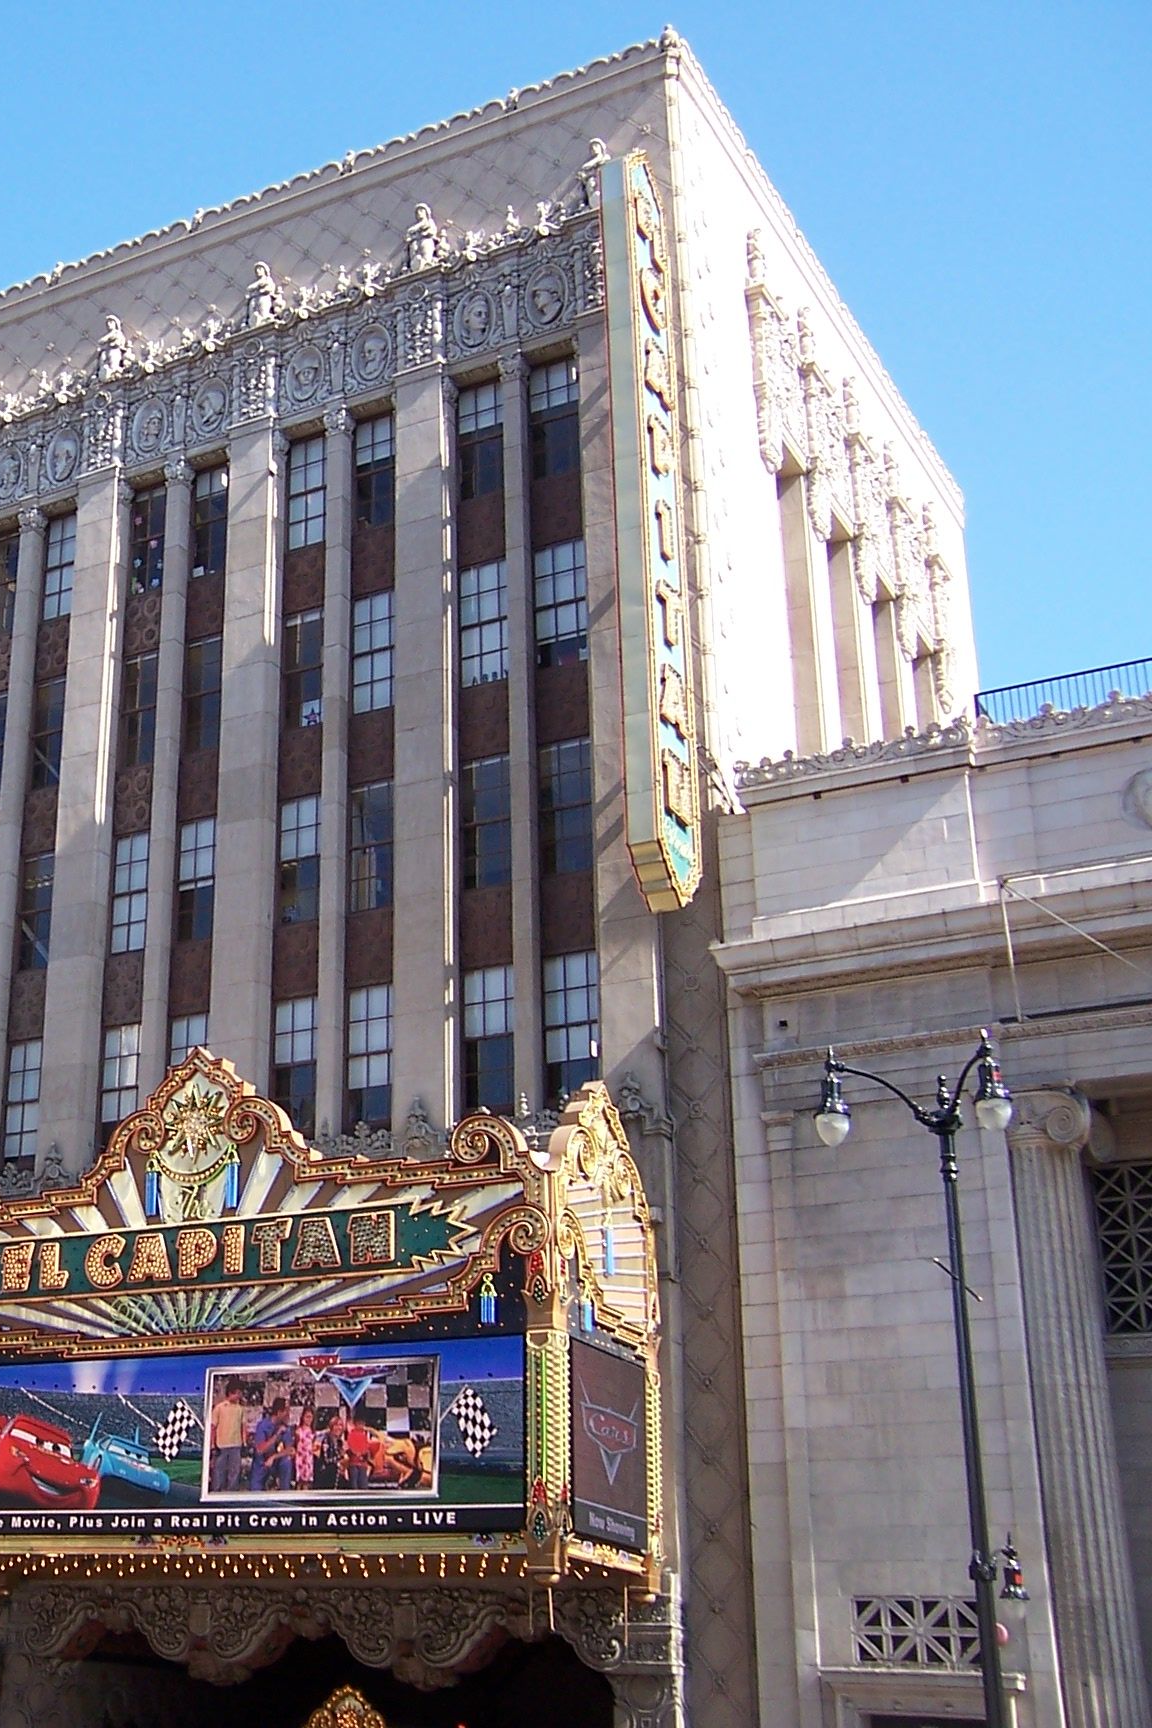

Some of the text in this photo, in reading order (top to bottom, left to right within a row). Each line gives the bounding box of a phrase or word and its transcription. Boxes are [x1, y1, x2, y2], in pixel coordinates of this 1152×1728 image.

[180, 1184, 212, 1220] The
[1, 1209, 397, 1292] EL CAPITAN
[588, 1412, 630, 1445] Cars
[11, 1516, 62, 1530] Movie,
[69, 1516, 103, 1528] Plus
[111, 1515, 146, 1528] Join
[153, 1518, 163, 1527] a
[170, 1515, 208, 1528] Real
[215, 1514, 241, 1528] Pit
[249, 1514, 293, 1527] Crew
[301, 1514, 318, 1527] in
[326, 1512, 388, 1526] Action
[412, 1511, 457, 1525] LIVE
